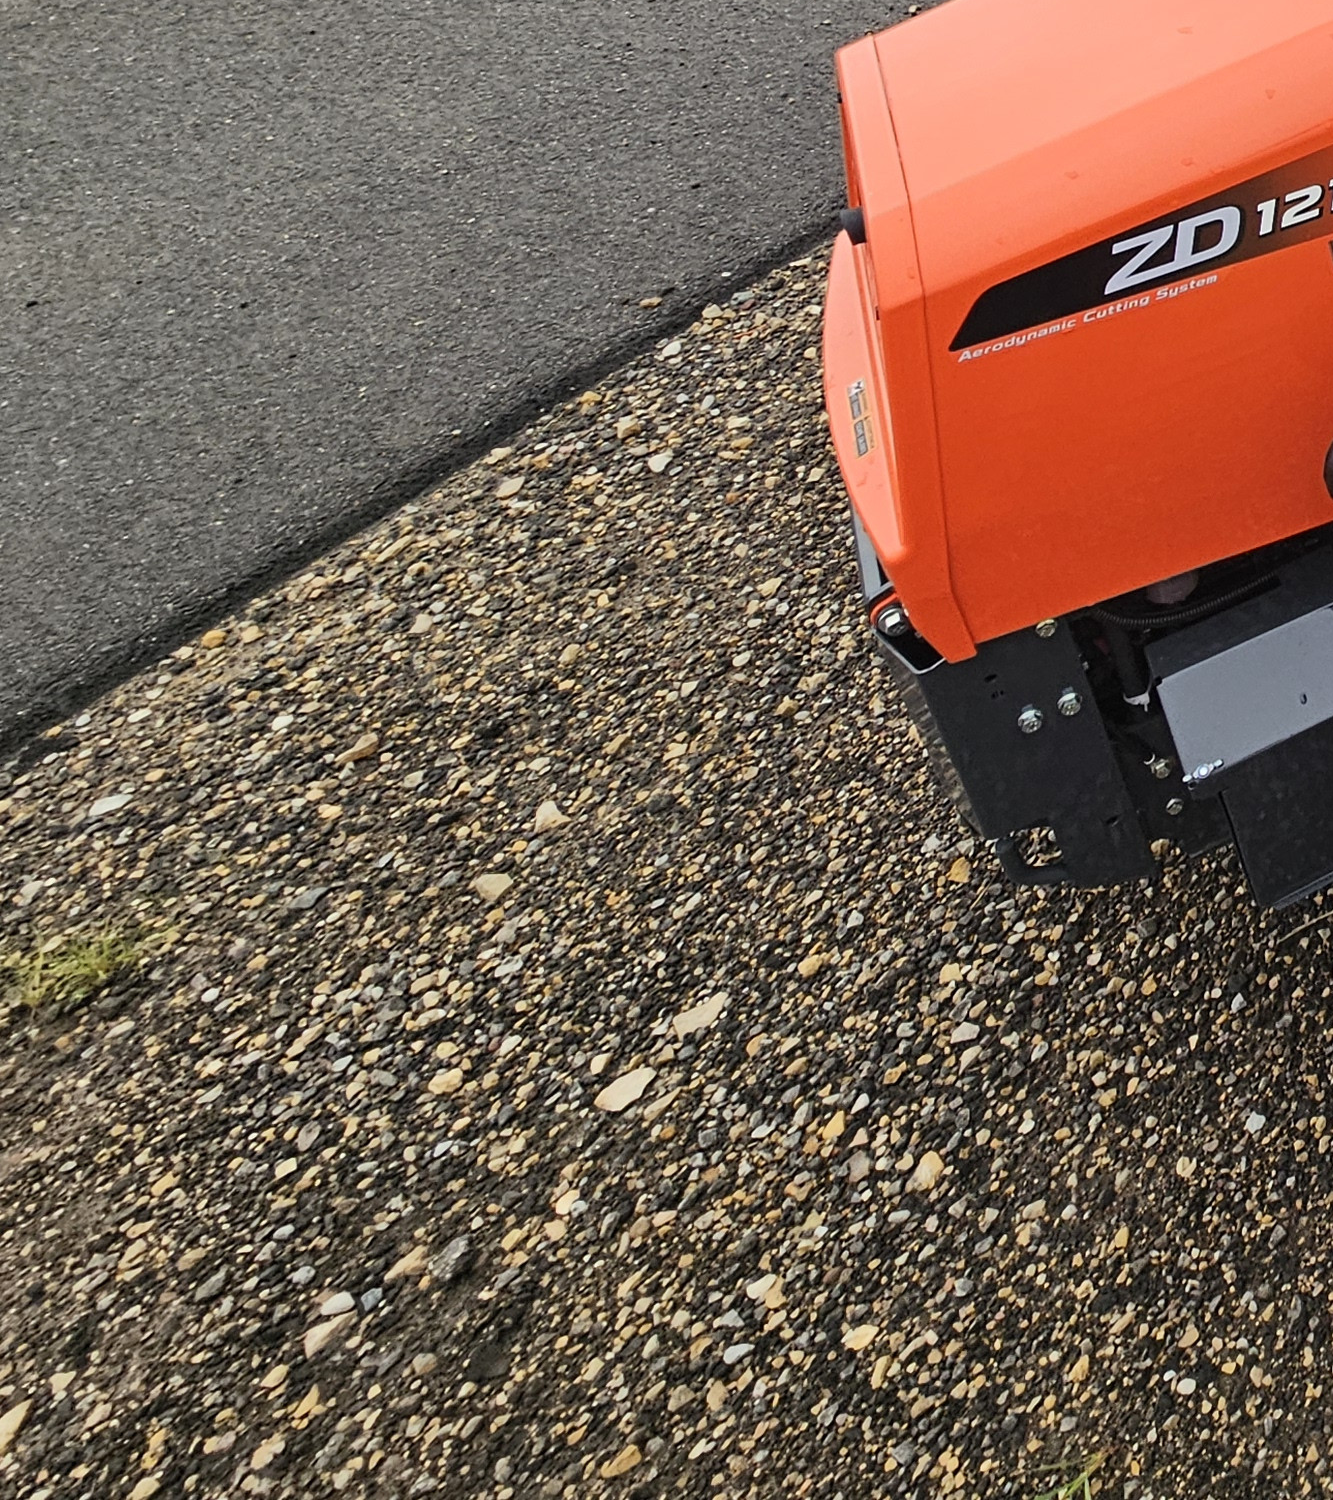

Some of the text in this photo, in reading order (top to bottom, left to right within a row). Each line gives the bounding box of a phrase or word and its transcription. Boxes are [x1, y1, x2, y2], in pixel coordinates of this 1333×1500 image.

[1103, 205, 1241, 296] ZD
[957, 274, 1218, 363] Aerodynamic Cutting System
